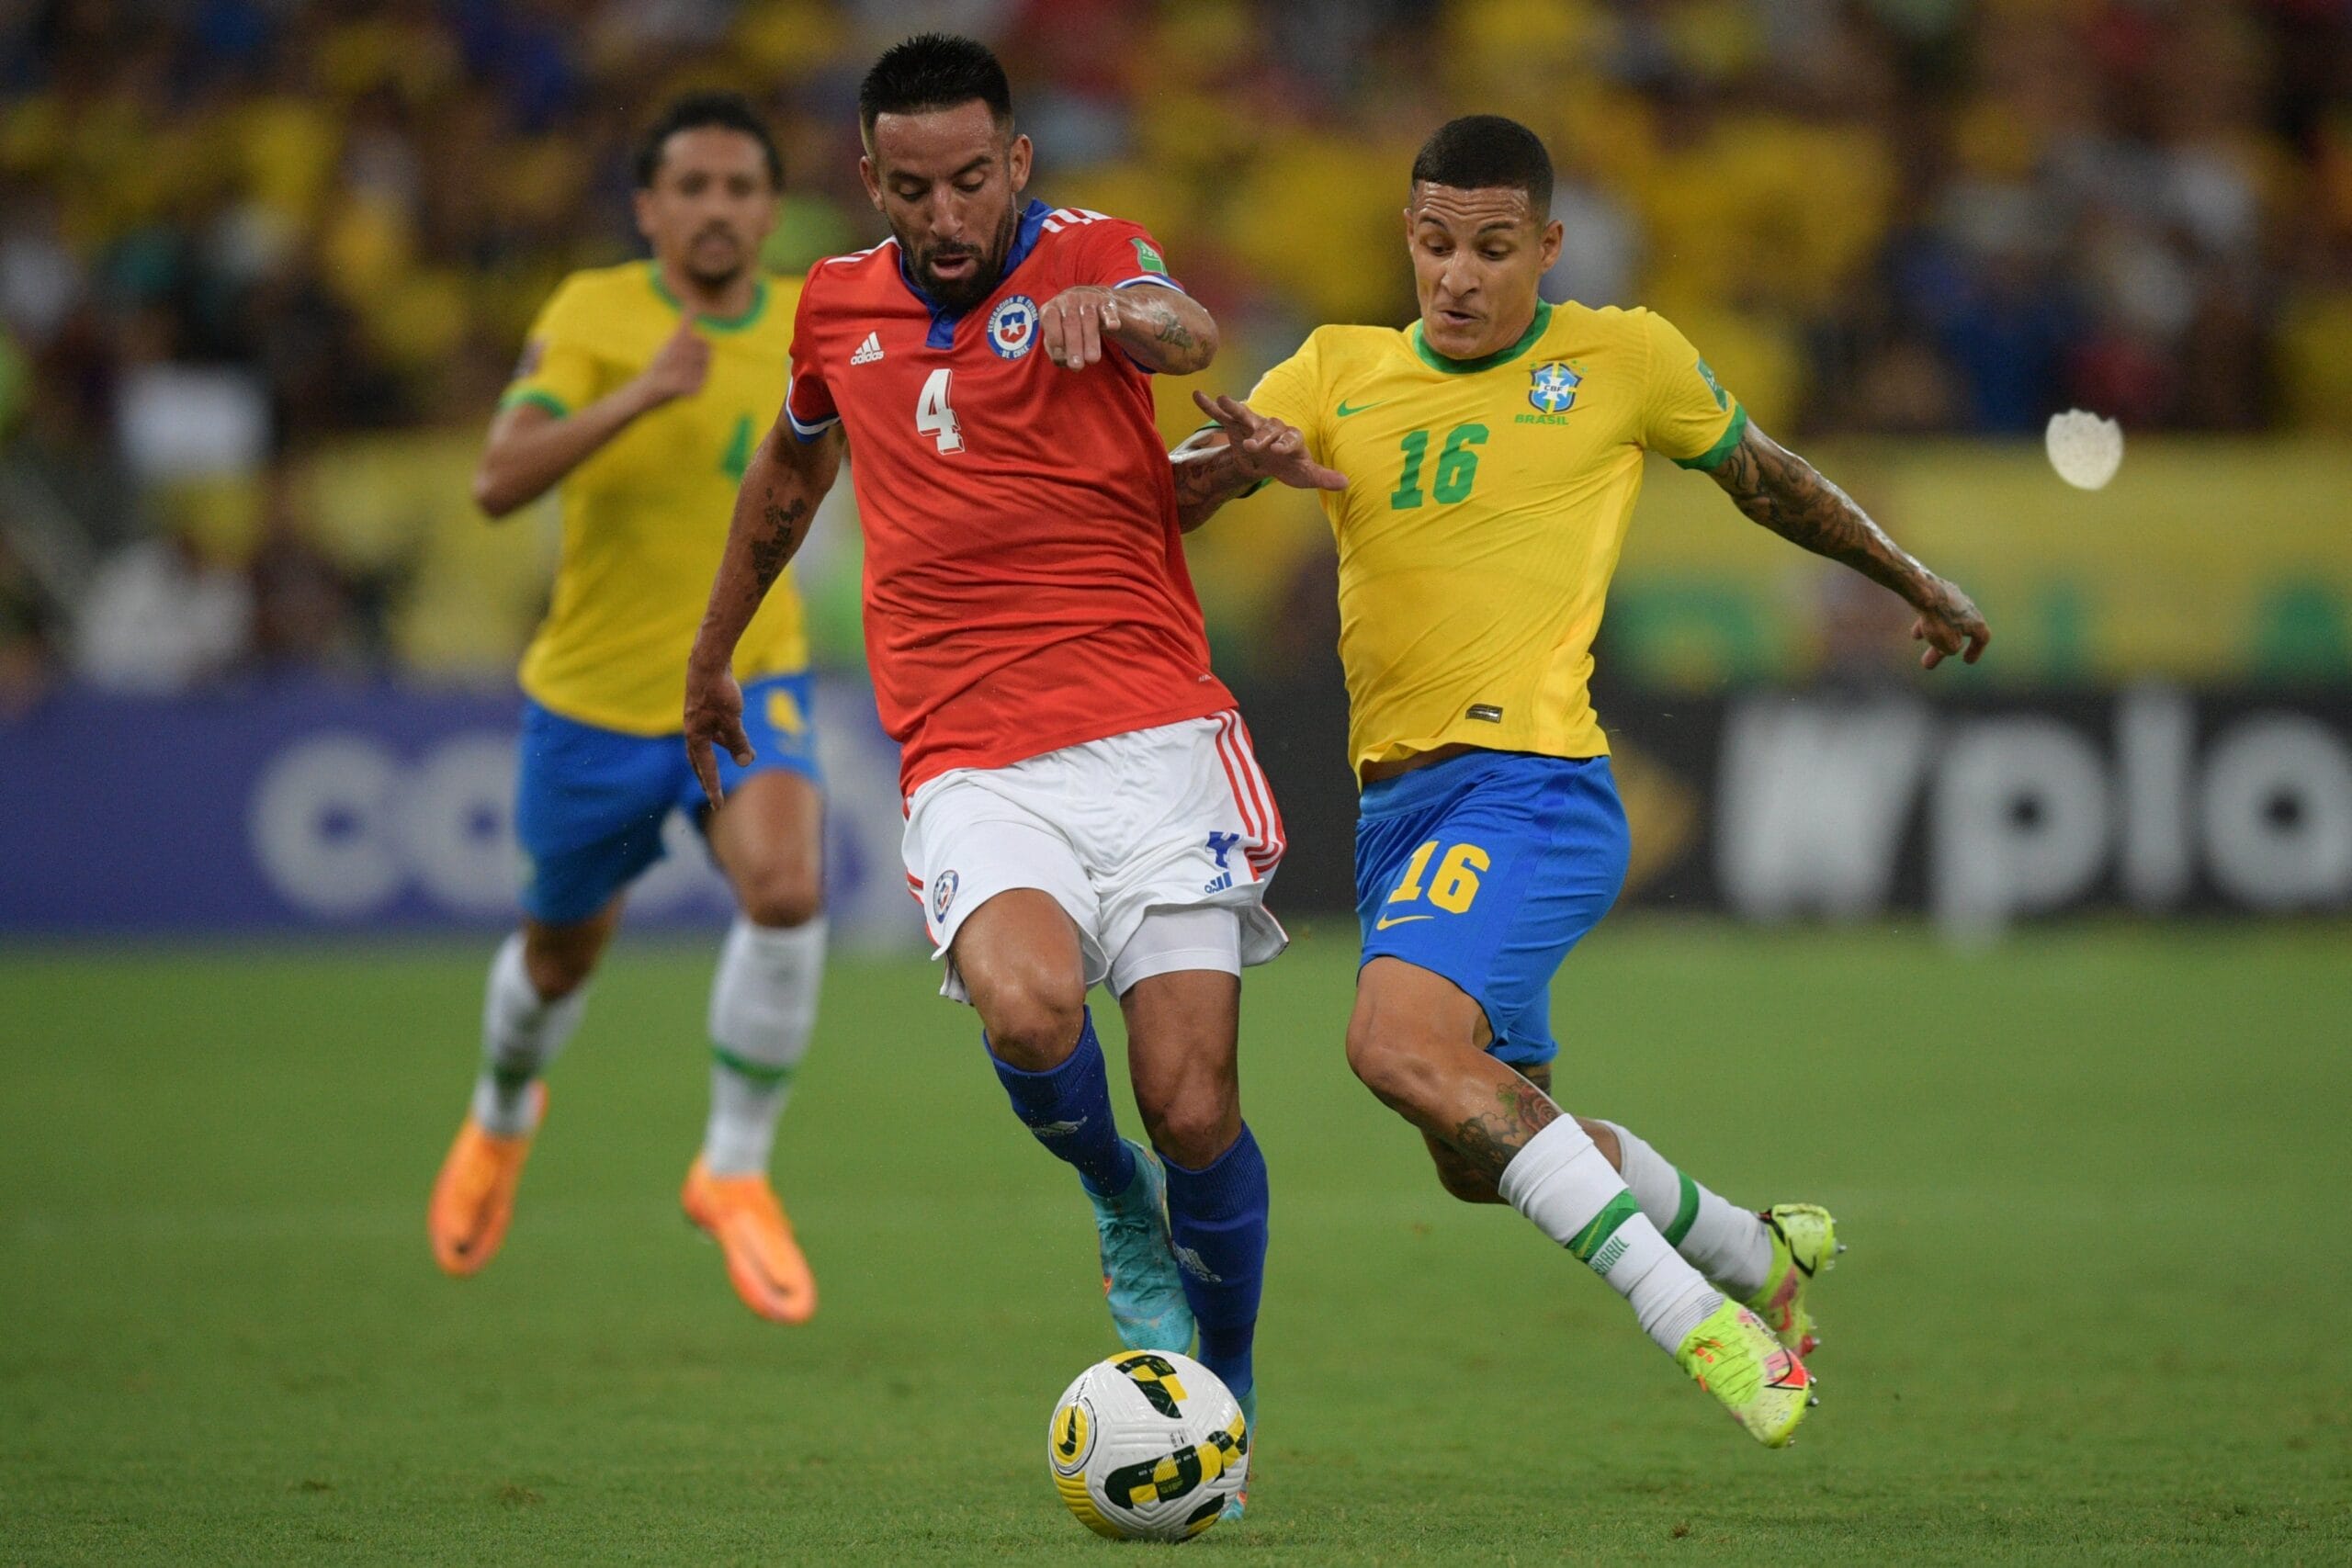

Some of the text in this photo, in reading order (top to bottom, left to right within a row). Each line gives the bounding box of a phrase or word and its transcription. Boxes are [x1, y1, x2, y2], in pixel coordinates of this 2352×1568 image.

[850, 350, 884, 366] adidas
[916, 368, 965, 456] 4
[1514, 413, 1569, 425] BRASIL
[1391, 423, 1490, 511] 16
[1386, 840, 1492, 915] 16
